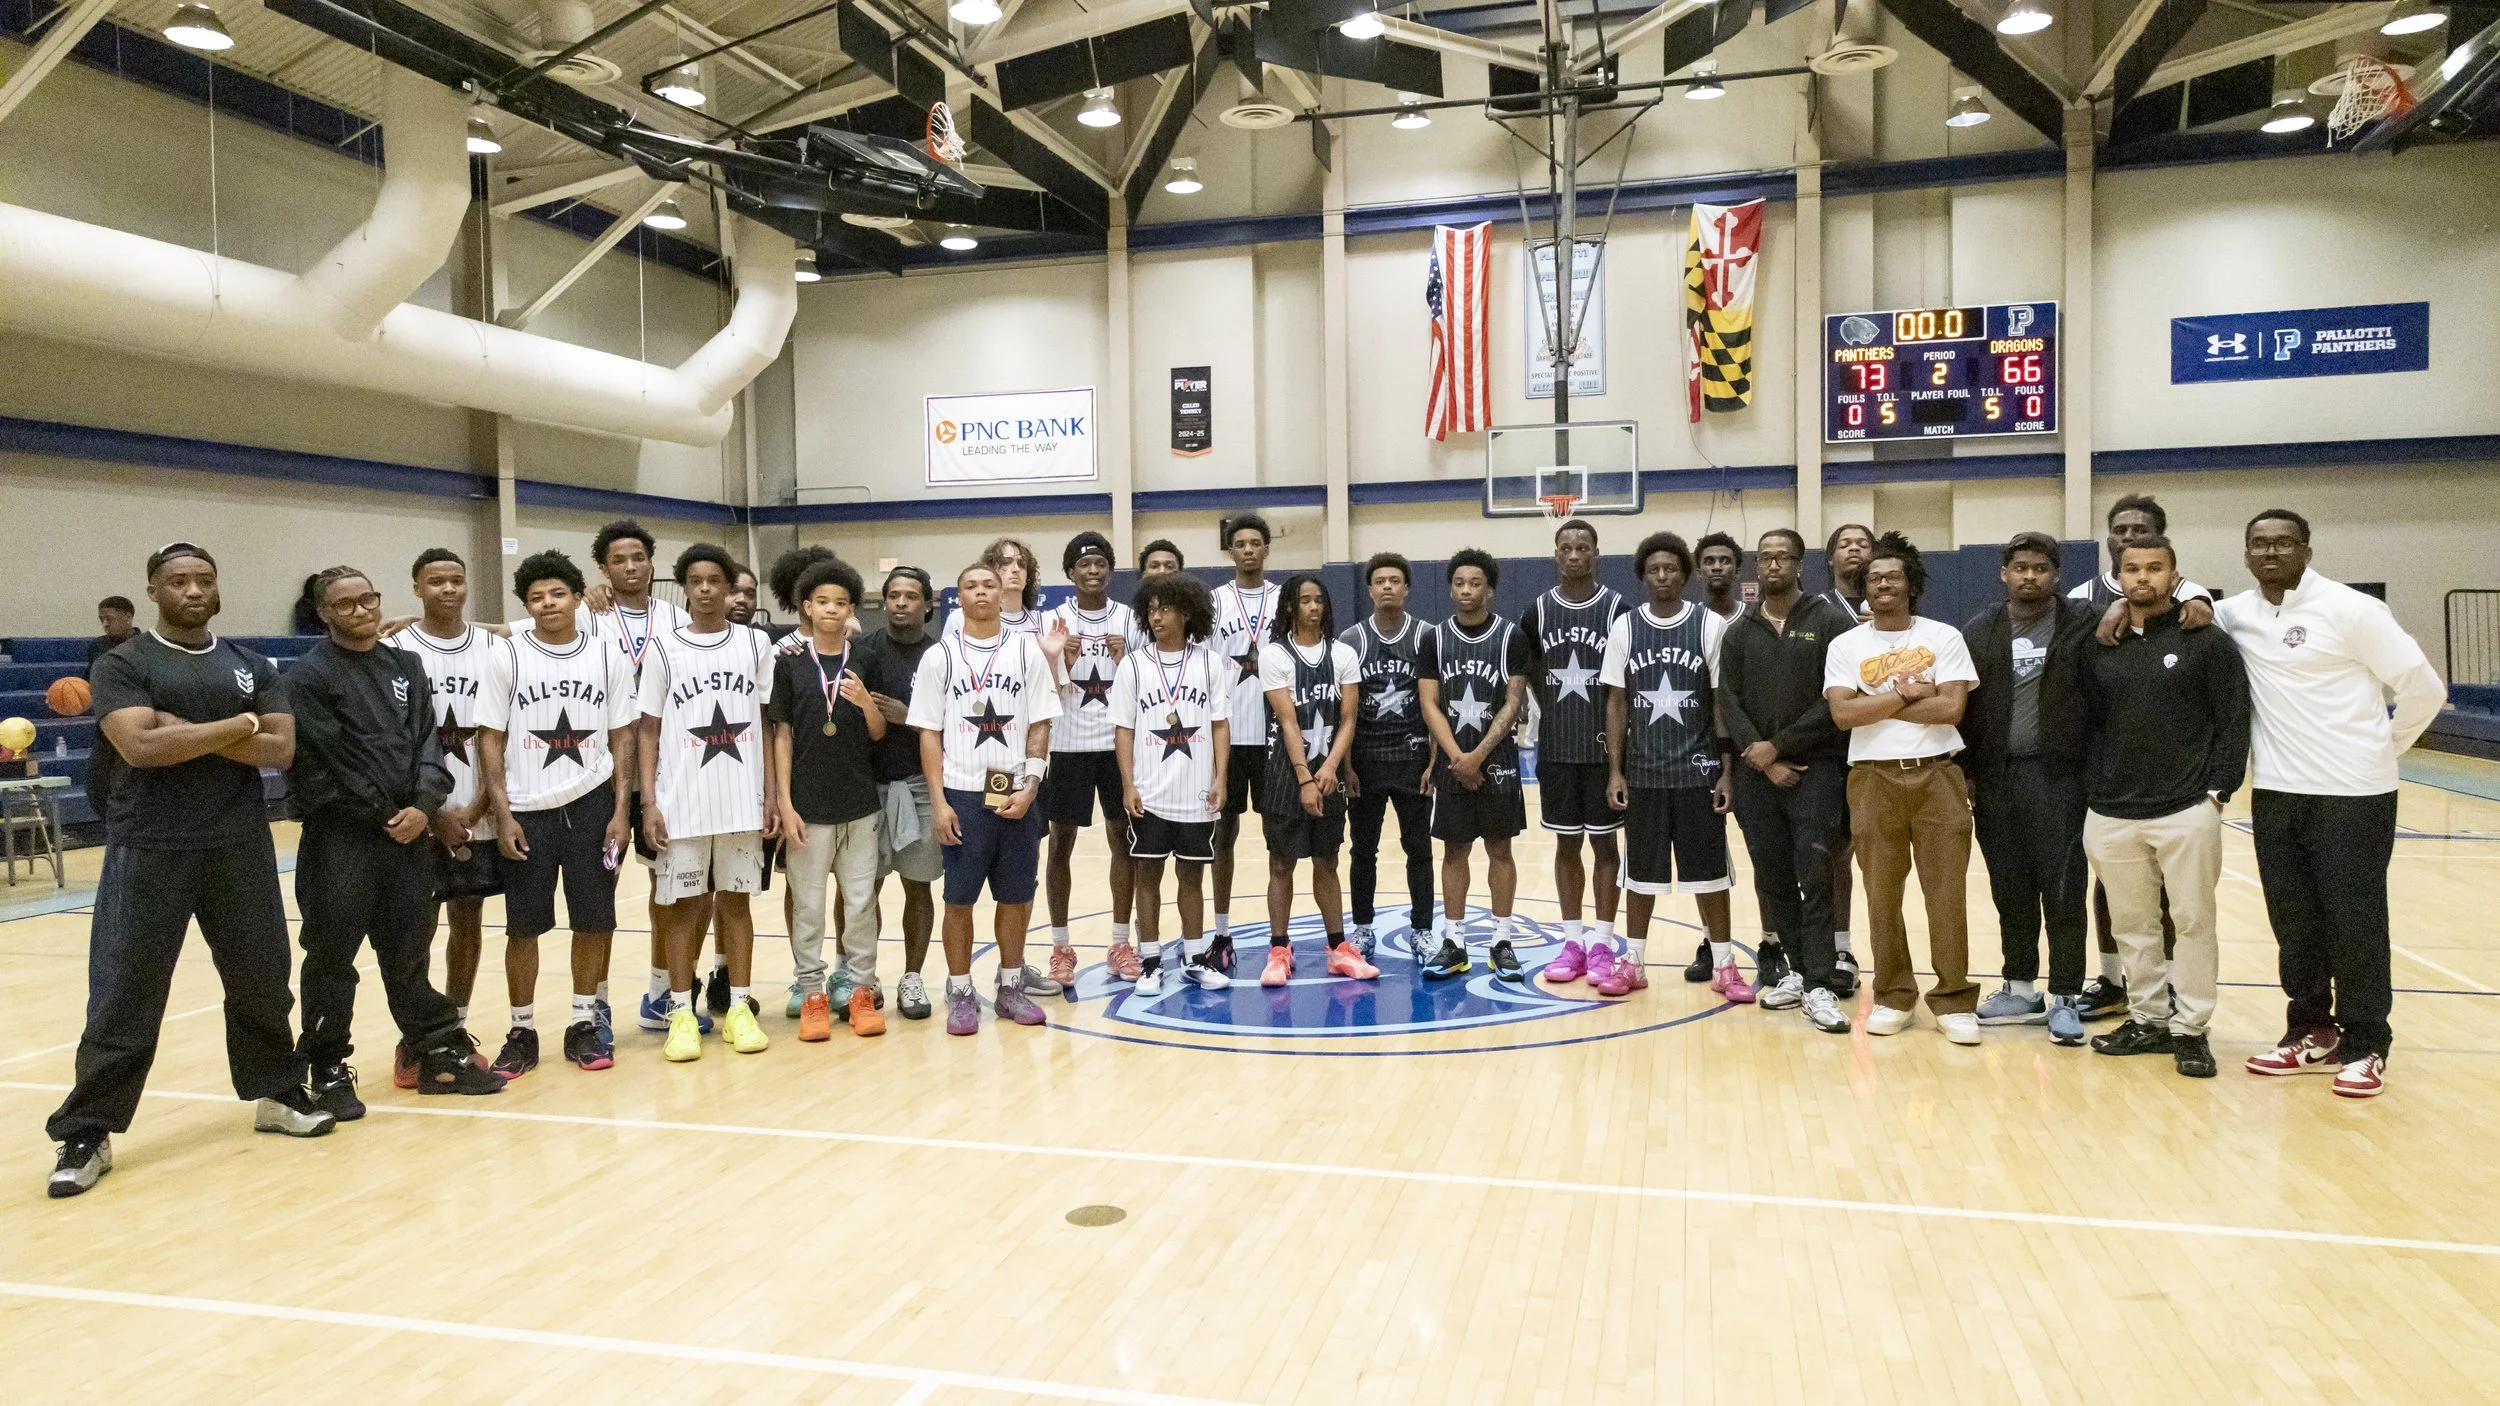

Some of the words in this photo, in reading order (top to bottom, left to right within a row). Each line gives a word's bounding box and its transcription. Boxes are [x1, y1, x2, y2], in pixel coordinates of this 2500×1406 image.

[1898, 310, 1963, 341] 00.0
[2315, 327, 2392, 341] PALLOTTI
[1834, 347, 1895, 362] PANTHERS
[1923, 350, 1956, 361] PERIOD
[1990, 338, 2044, 354] DRAGONS
[2311, 339, 2397, 354] PANTHERS
[1851, 364, 1885, 390] 73
[1932, 363, 1947, 385] 2
[2004, 356, 2042, 383] 66
[1838, 393, 1865, 404] FOULS
[1911, 390, 1944, 400] PLAYER
[1947, 388, 1970, 398] FOUL
[2015, 385, 2044, 395] FOULS
[1849, 404, 1862, 425] 0
[1880, 403, 1896, 424] 5
[1985, 398, 2000, 420] 5
[2027, 396, 2041, 417] 0
[960, 420, 1010, 441] PNC
[1017, 417, 1085, 437] BANK
[1837, 429, 1865, 439] SCORE
[1924, 425, 1954, 434] MATCH
[2015, 421, 2044, 431] SCORE
[962, 445, 1006, 456] LEADING
[1010, 443, 1030, 453] THE
[1034, 442, 1059, 452] WAY
[1542, 626, 1608, 654] ALL-STAR
[1629, 647, 1703, 675] ALL-STAR
[428, 676, 479, 699] L-STA
[517, 680, 605, 710] ALL-STAR
[672, 671, 755, 710] ALL-STAR
[952, 673, 1022, 700] ALLSTAR
[1294, 683, 1336, 707] LL-STA
[1140, 686, 1207, 713] ALLTAR
[979, 718, 1017, 732] nubian
[548, 733, 598, 750] nubian
[703, 729, 755, 746] nubian
